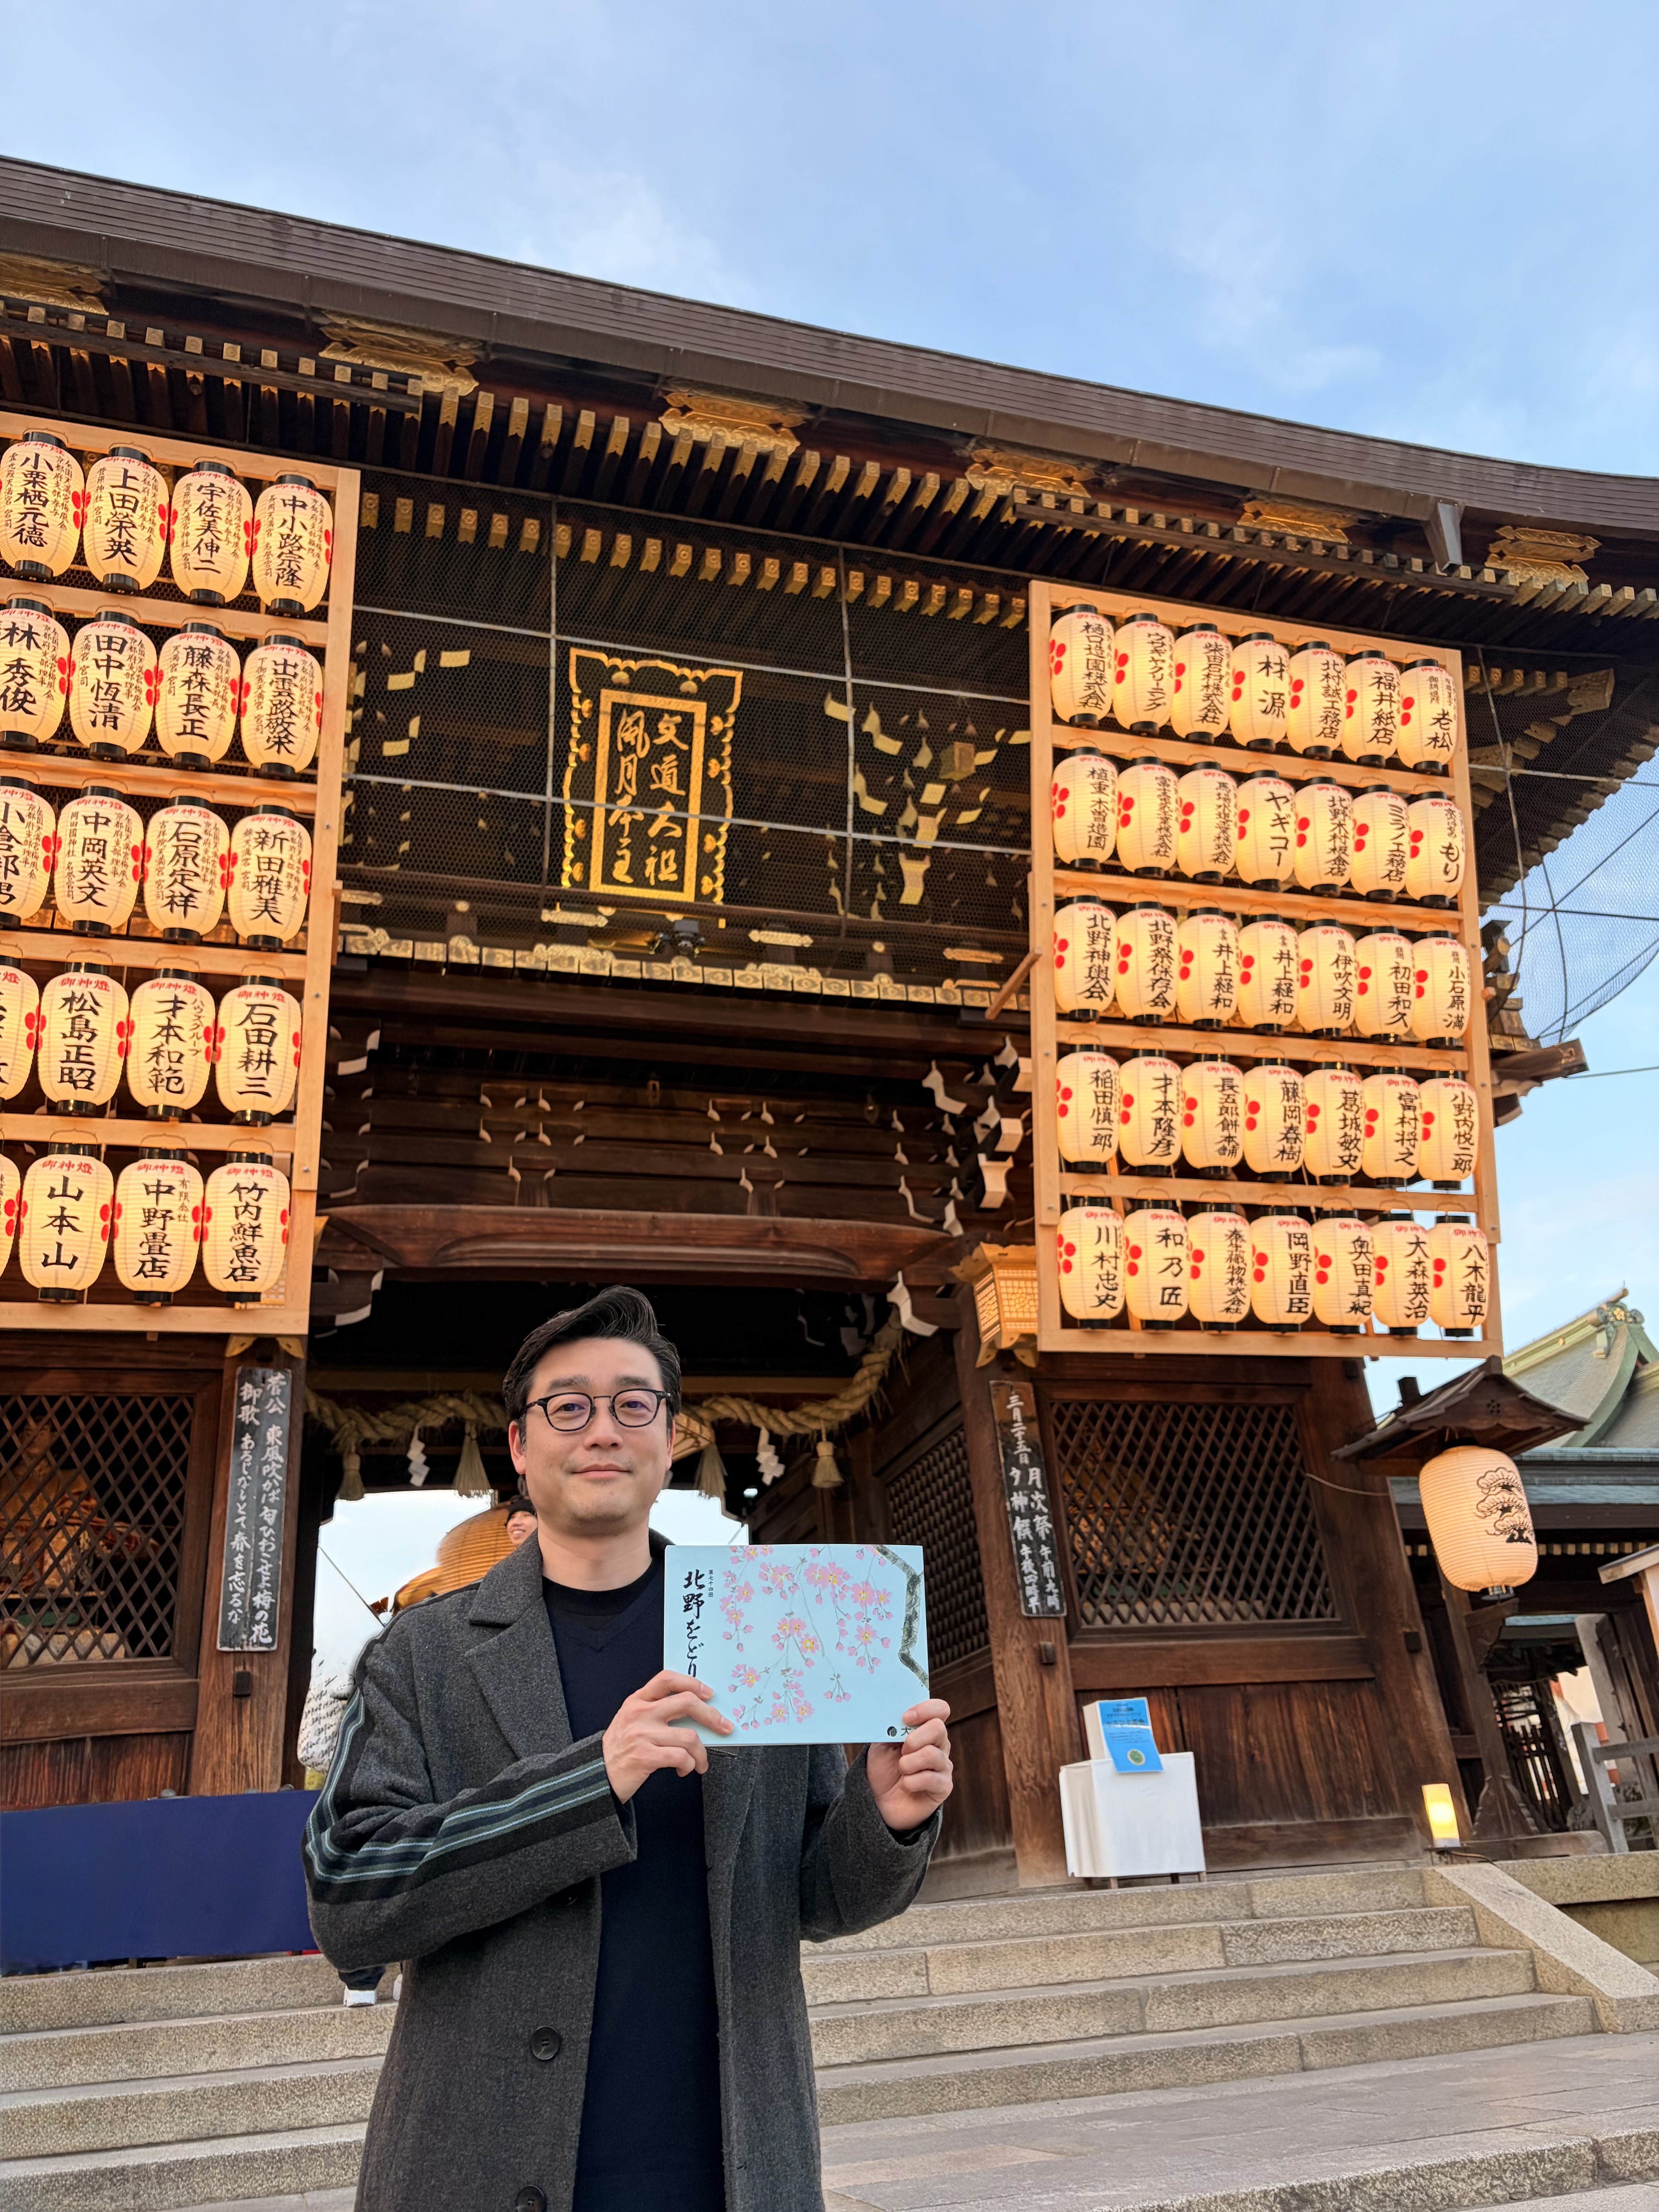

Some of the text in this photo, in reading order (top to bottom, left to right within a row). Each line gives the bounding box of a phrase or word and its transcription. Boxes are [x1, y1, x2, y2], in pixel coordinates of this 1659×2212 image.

[4, 509, 13, 528] 宮司
[9, 452, 54, 547] 小栗栖元徳
[192, 482, 226, 574] 宇佐美伸二
[275, 495, 308, 589] 中小路宗隆
[0, 621, 42, 716] 林秀俊
[79, 665, 89, 687] 宮司
[167, 675, 177, 696] 宮司
[175, 645, 215, 742] 藤森長正
[1317, 659, 1342, 740] 北村誠工務店
[1366, 670, 1396, 746] 福井紙店
[254, 714, 264, 734] 宮司
[1424, 708, 1453, 752] 老松
[0, 789, 35, 802] 神燈
[1264, 791, 1291, 867] ヤギコー
[72, 811, 112, 907] 中岡英文
[160, 821, 202, 920] 石原定祥
[242, 871, 251, 891] 宮司
[249, 828, 289, 926] 新田雅美
[1381, 803, 1406, 882] ミラノ工務店
[1439, 842, 1460, 883] もり
[155, 879, 165, 901] 宮司
[58, 977, 111, 992] 御神燈
[149, 982, 198, 996] 御神燈
[237, 991, 285, 1003] 御神燈
[1076, 914, 1111, 1002] 北野神輿会
[1143, 919, 1175, 1009] 北野祭保存会
[1329, 954, 1353, 1021] 伊吹文明
[1384, 962, 1411, 1028] 初田和久
[1443, 966, 1466, 1030] 小石原満
[57, 990, 104, 1091] 松島正昭
[145, 994, 187, 1094] 才本和範
[235, 1003, 280, 1098] 石田耕三
[1088, 1068, 1114, 1153] 稲田慎一郎
[41, 1160, 94, 1175] 御神燈
[136, 1164, 185, 1175] 御神燈
[177, 1177, 190, 1223] 有限会社
[226, 1168, 274, 1178] 御神燈
[41, 1175, 84, 1269] 山本山
[132, 1178, 175, 1279] 中野畳店
[223, 1181, 269, 1282] 竹内鮮魚店
[1089, 1225, 1120, 1309] 川村忠史
[1155, 1227, 1184, 1307] 和乃匠
[1285, 1231, 1312, 1314] 岡野直臣
[1345, 1235, 1373, 1316] 奥田真紀
[1404, 1234, 1430, 1319] 大森英治
[1460, 1244, 1487, 1325] 八木龍平
[237, 1381, 263, 1425] 御歌
[264, 1372, 287, 1414] 菅公
[1006, 1395, 1032, 1465] 三月二十五日
[683, 1569, 706, 1678] 北野をどり
